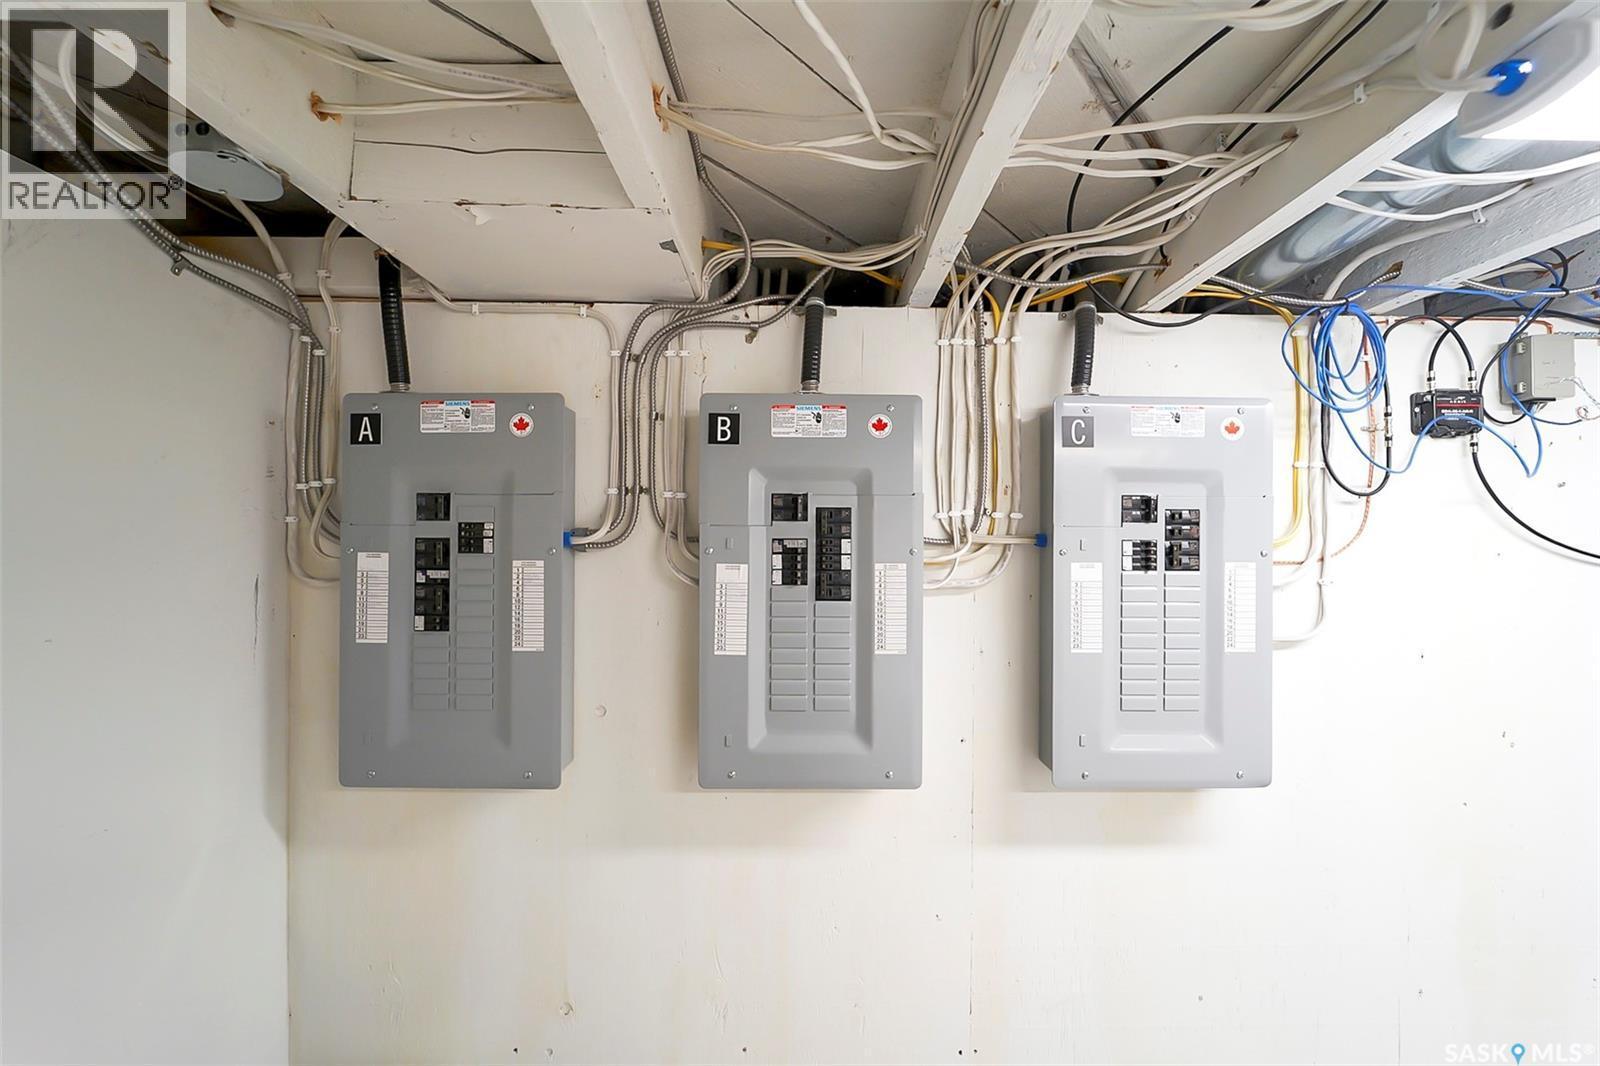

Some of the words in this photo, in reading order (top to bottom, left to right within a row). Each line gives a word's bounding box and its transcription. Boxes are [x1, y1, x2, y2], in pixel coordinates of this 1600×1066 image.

[358, 416, 373, 442] A
[717, 416, 731, 442] B
[1071, 419, 1086, 445] C
